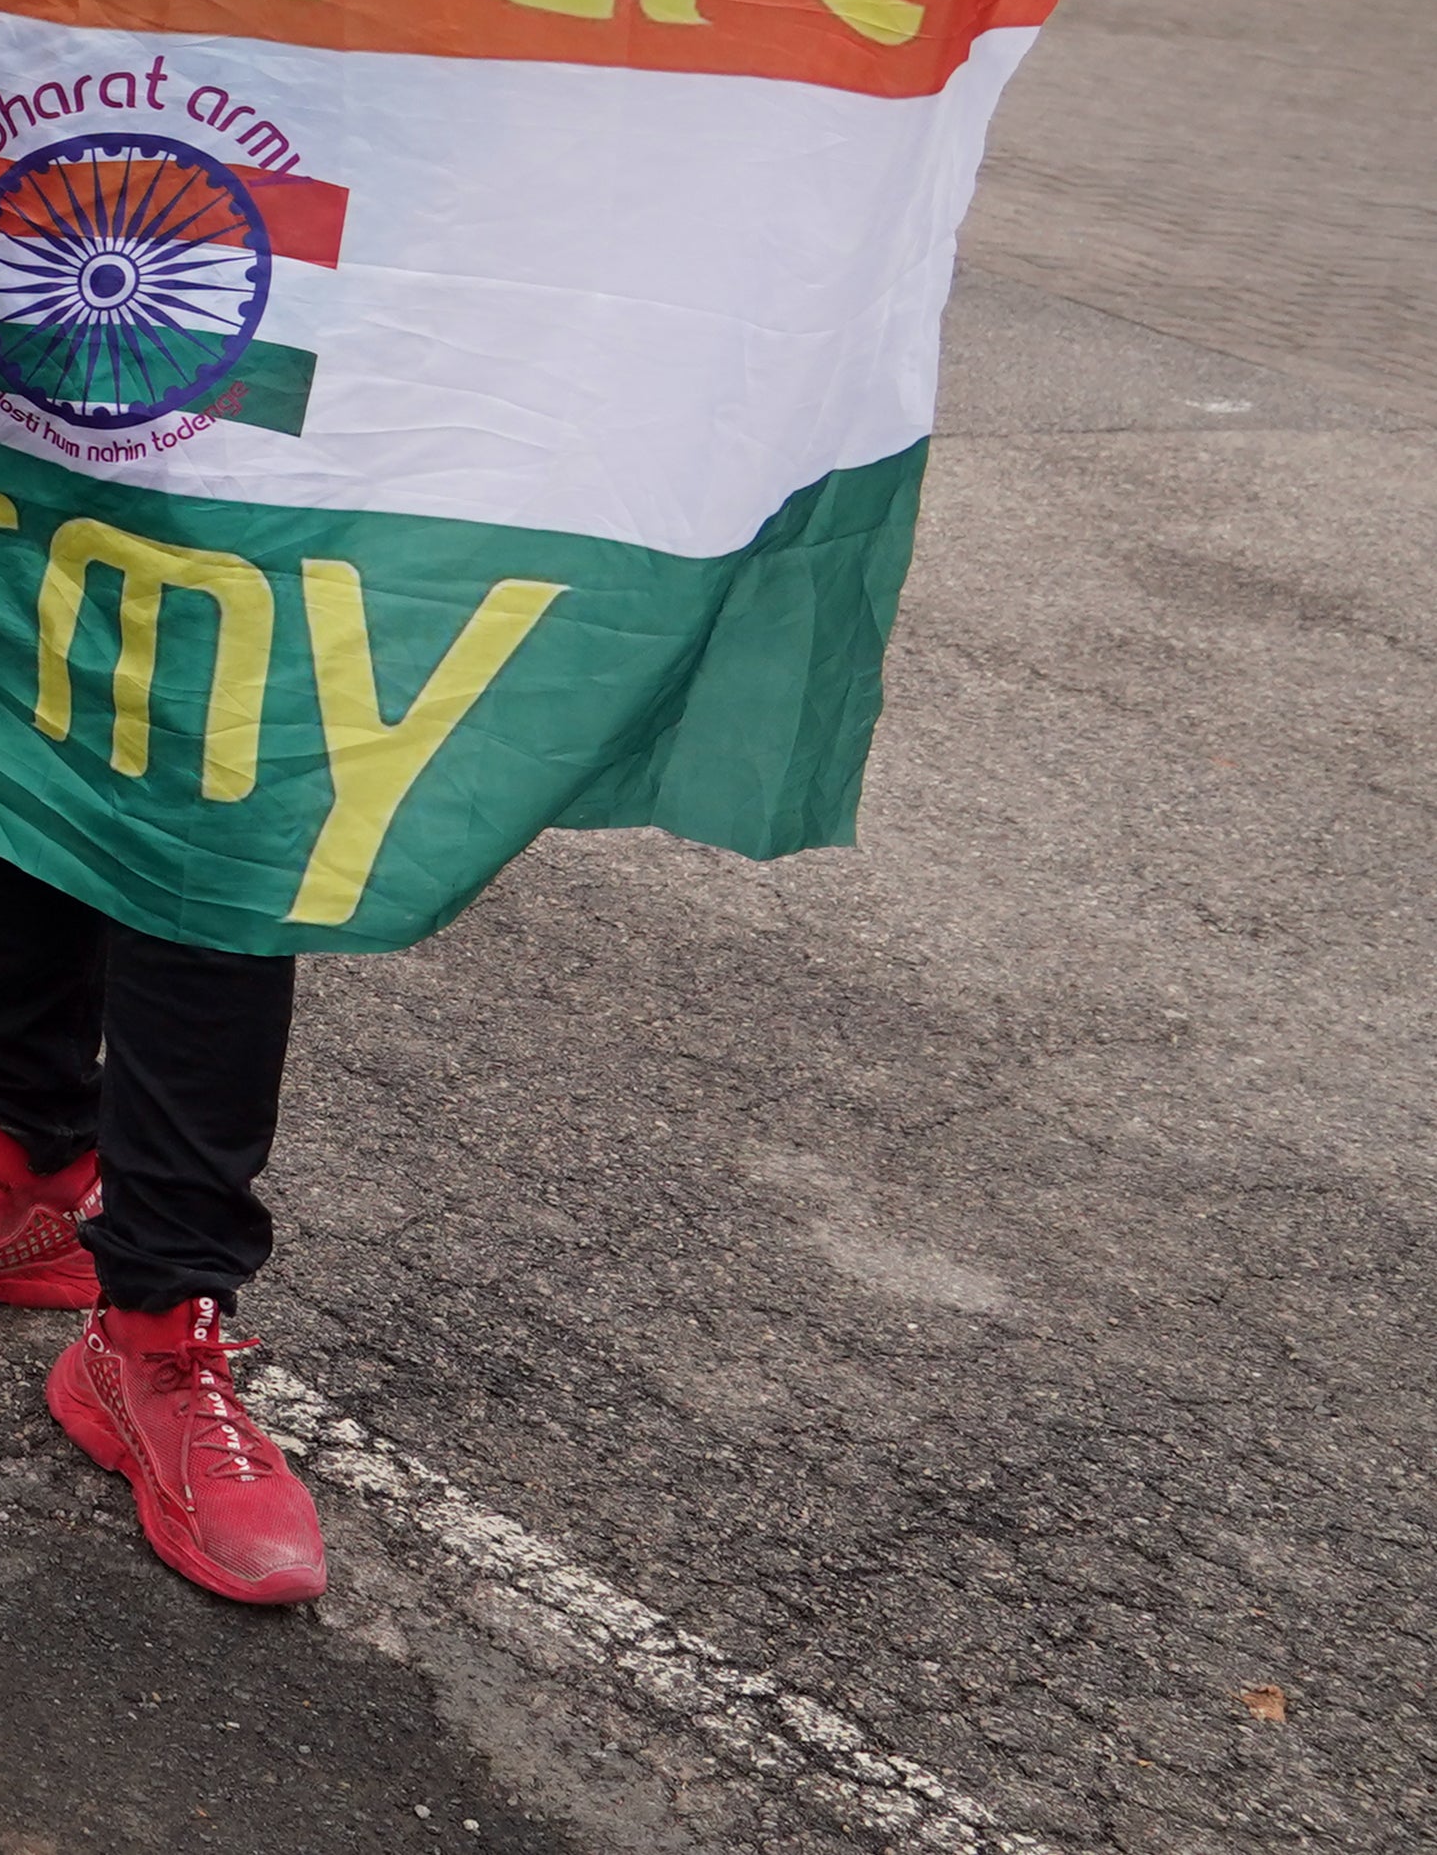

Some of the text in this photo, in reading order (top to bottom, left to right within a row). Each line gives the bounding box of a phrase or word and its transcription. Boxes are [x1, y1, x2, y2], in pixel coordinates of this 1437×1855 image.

[186, 85, 315, 188] army
[42, 422, 80, 459] hum
[88, 438, 148, 464] nahin
